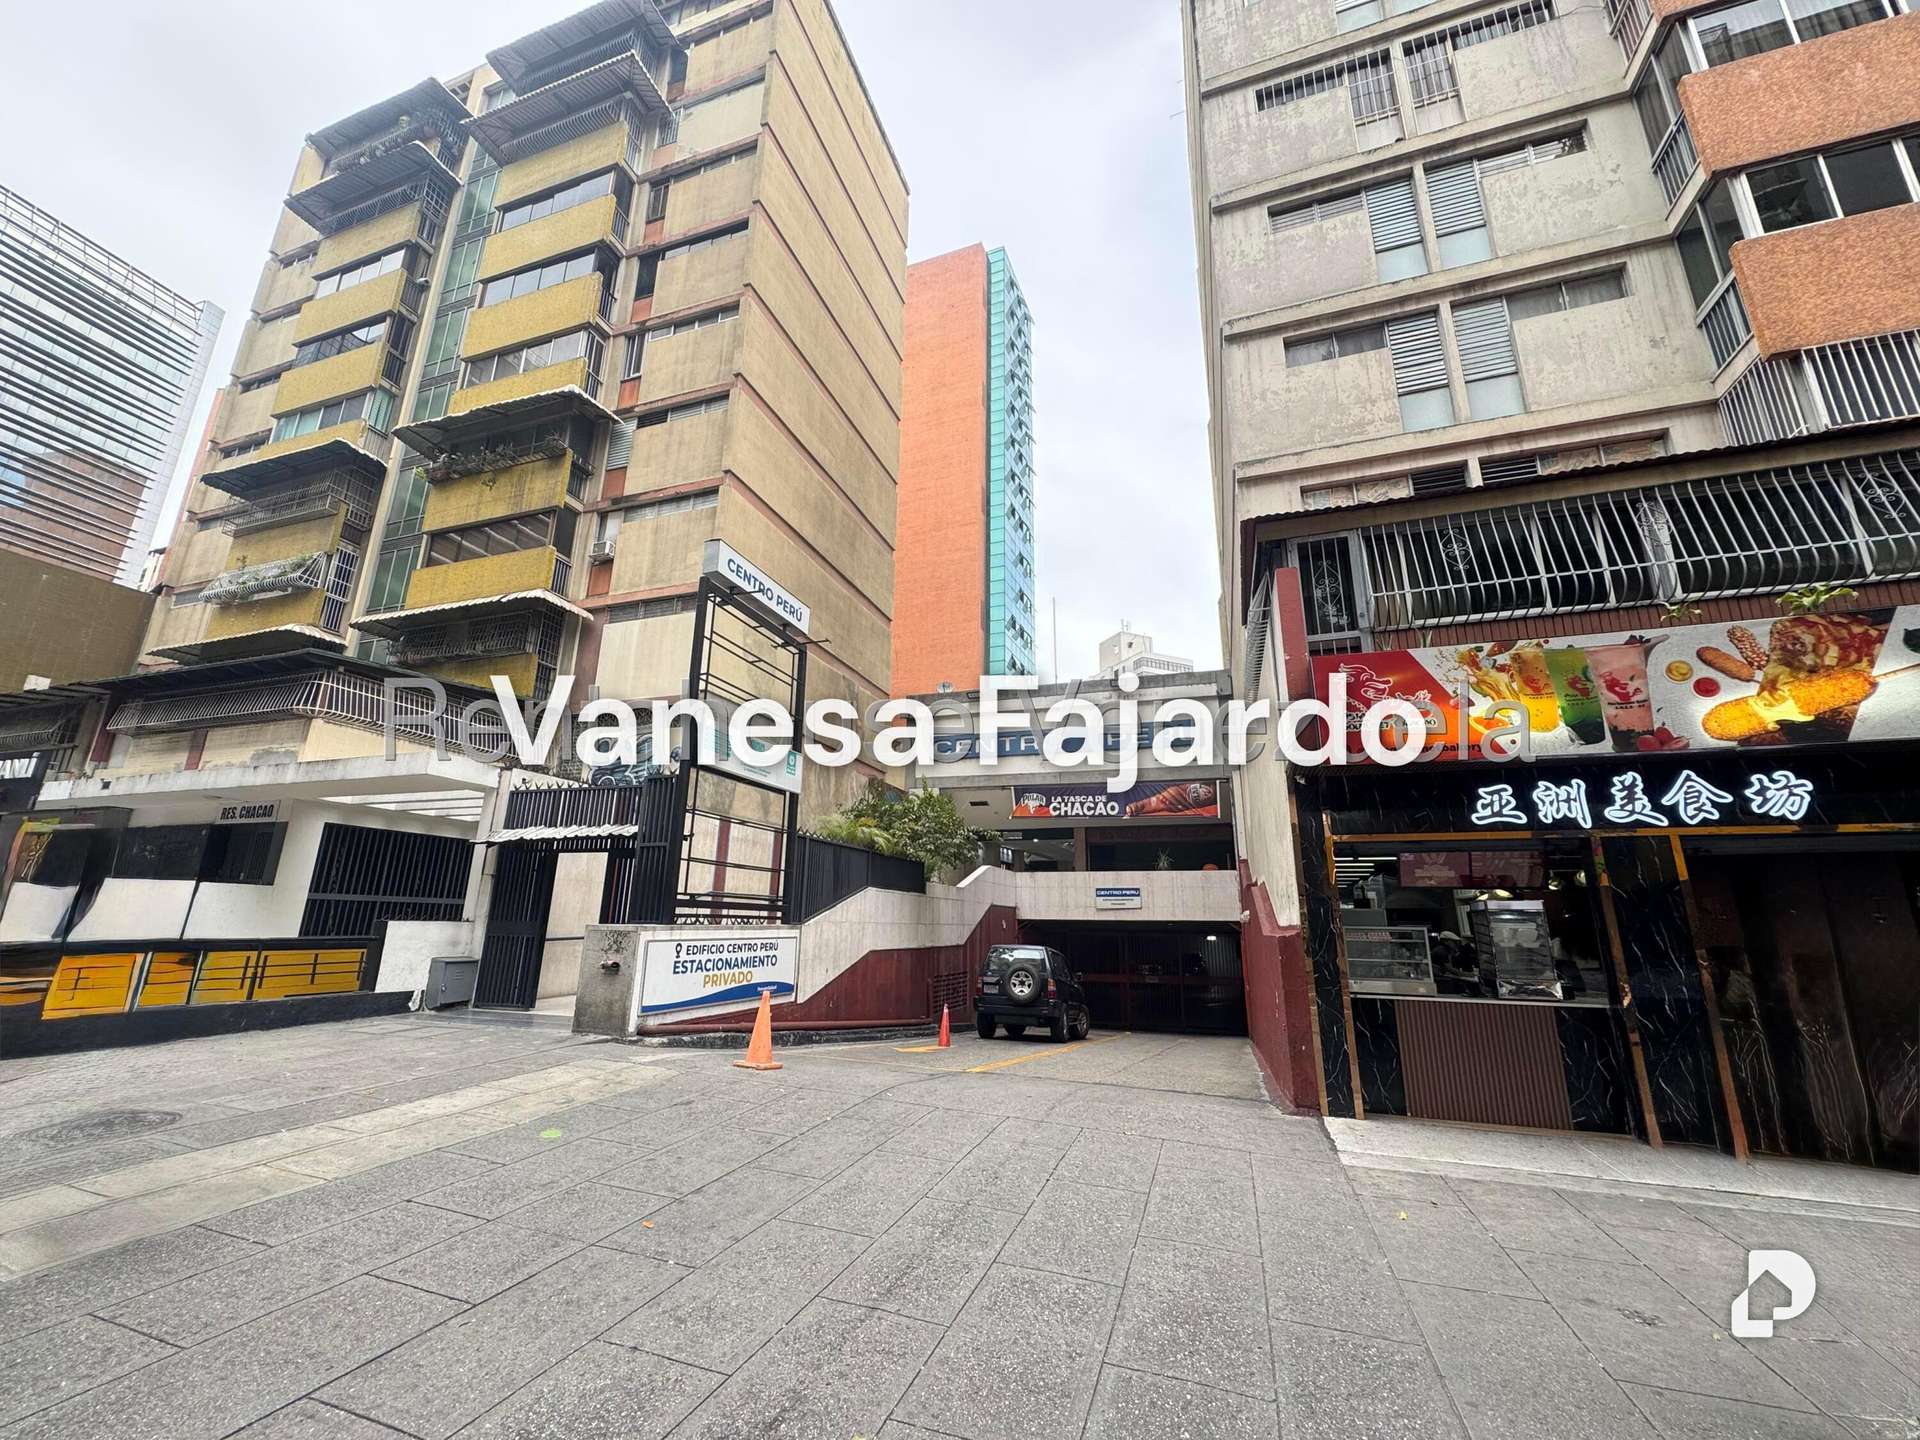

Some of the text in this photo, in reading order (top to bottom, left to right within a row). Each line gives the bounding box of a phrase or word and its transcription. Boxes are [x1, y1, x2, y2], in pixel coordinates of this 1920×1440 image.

[727, 558, 803, 622] CENTRO PERÚ
[220, 804, 274, 820] RES. CHACAO
[1049, 801, 1119, 816] CHACAO
[686, 940, 779, 956] EDIFICIO CENTRO PERÚ
[672, 954, 778, 975] ESTACIONAMIENTO
[703, 970, 753, 988] PRIVADO
